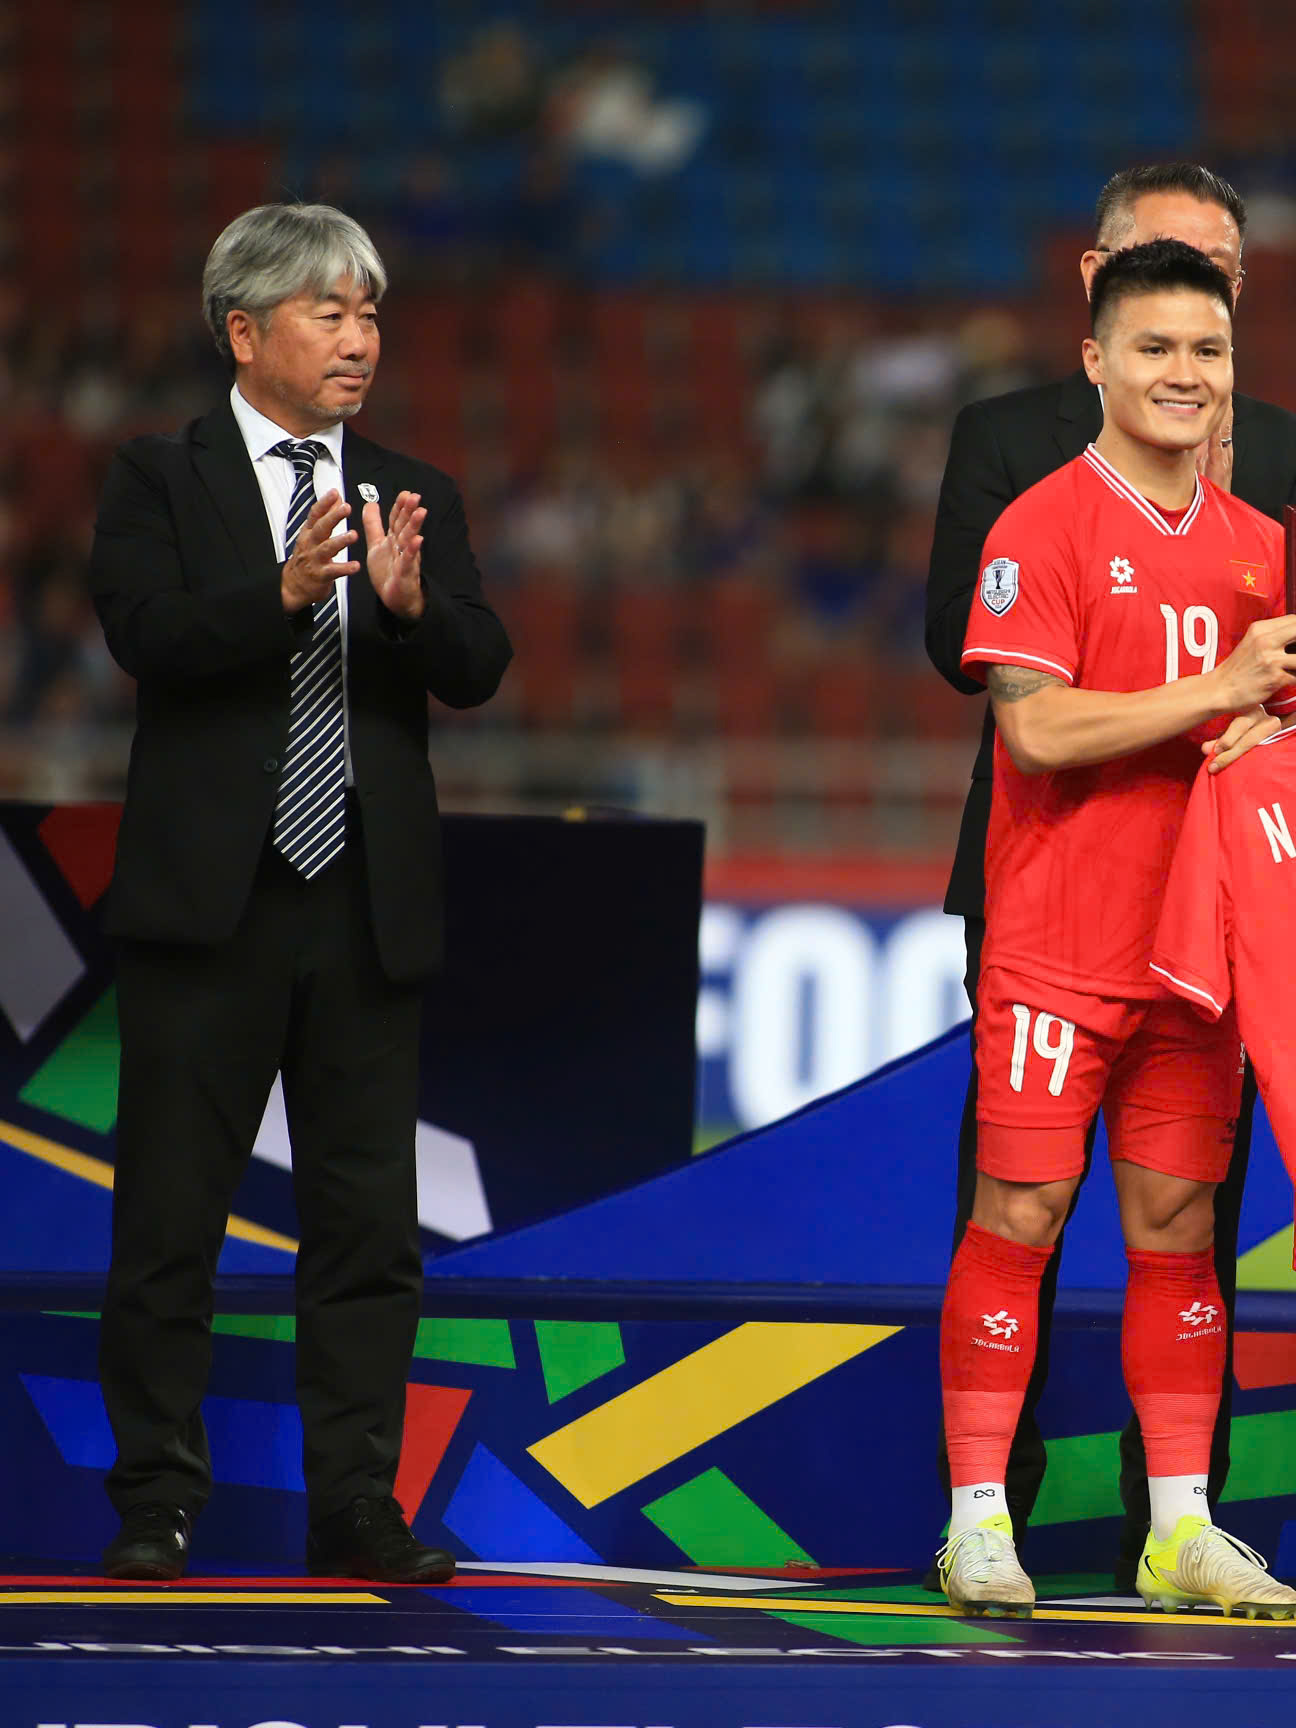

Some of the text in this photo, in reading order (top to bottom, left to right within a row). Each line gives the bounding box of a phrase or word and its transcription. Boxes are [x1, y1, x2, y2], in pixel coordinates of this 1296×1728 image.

[1160, 604, 1219, 684] 19
[1009, 1004, 1076, 1096] 19
[496, 1646, 1235, 1661] ELECTRIC
